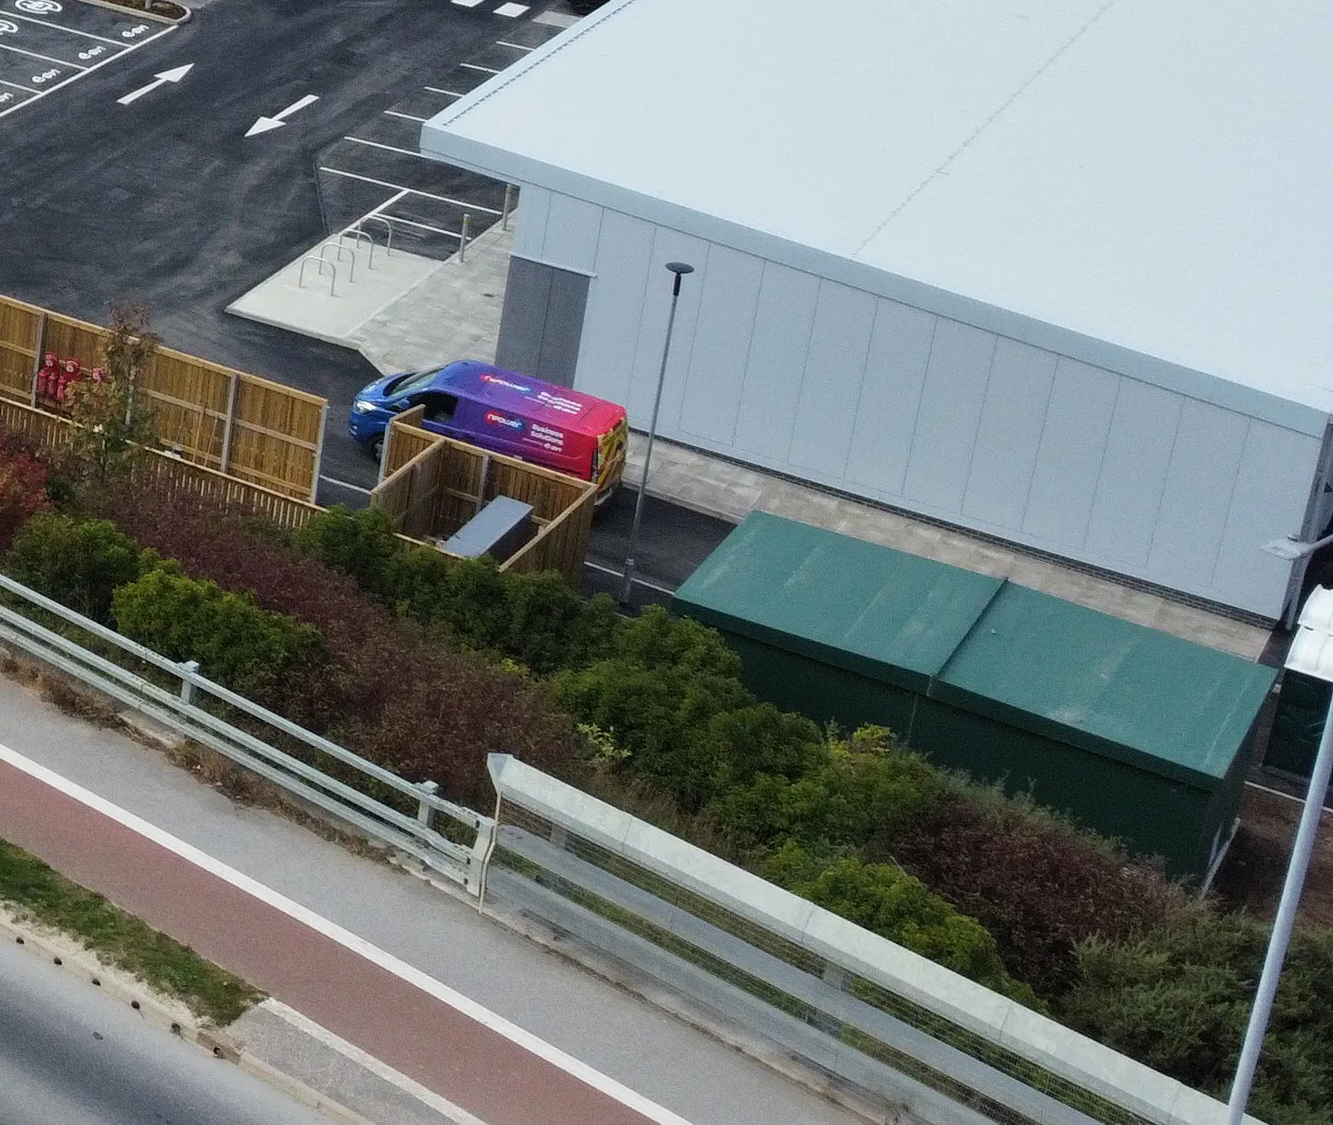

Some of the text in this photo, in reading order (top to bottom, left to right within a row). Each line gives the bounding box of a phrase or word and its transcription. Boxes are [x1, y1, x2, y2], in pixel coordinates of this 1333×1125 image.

[487, 413, 522, 428] npower
[530, 431, 564, 446] Solutions
[532, 424, 564, 438] Business
